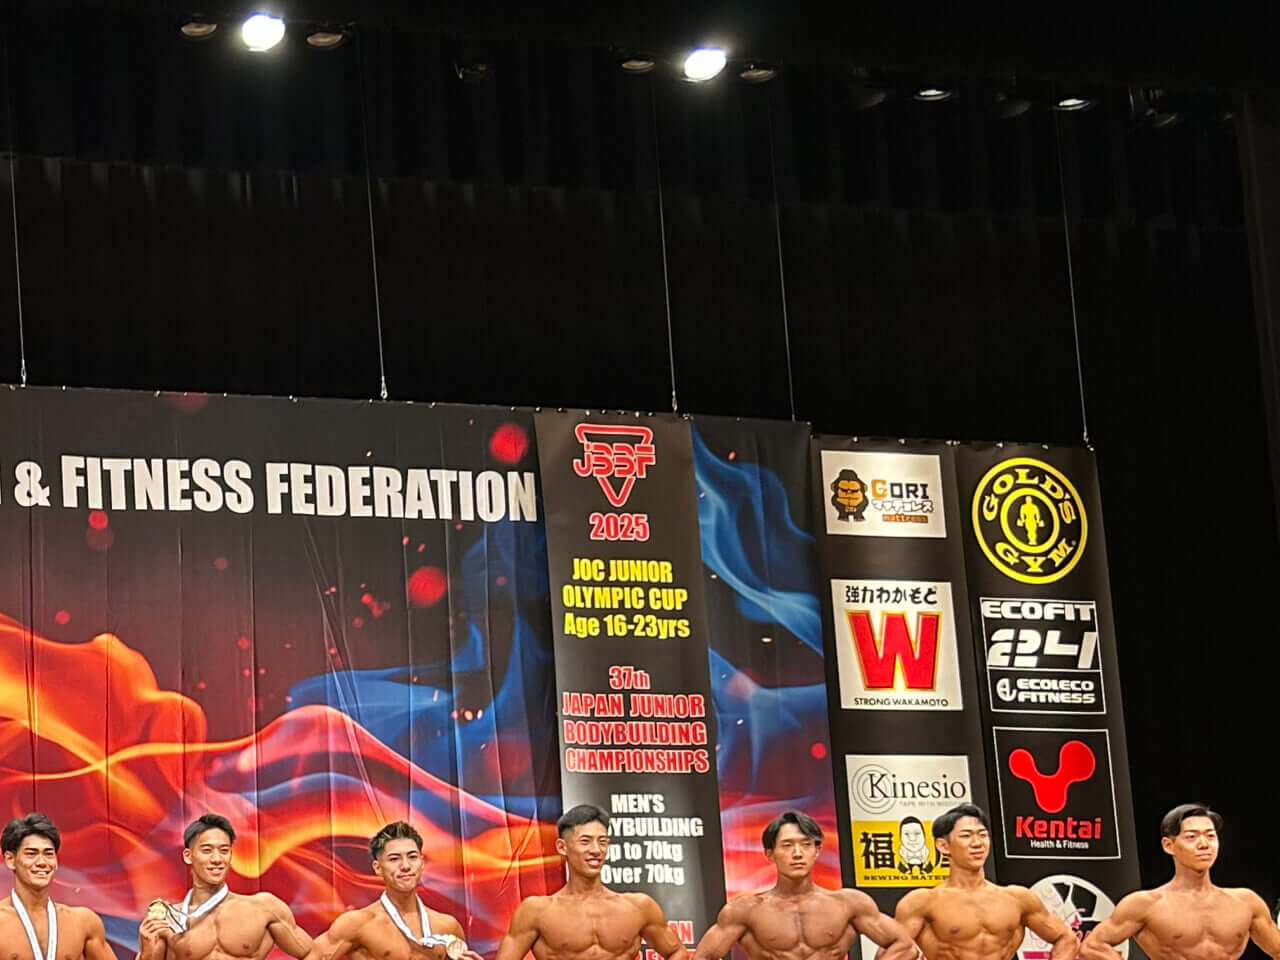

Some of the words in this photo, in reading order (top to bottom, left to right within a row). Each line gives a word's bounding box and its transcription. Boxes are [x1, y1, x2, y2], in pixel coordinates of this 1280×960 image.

[14, 461, 51, 507] &
[60, 455, 255, 514] FITNESS
[265, 462, 538, 523] FEDERATION
[871, 479, 929, 500] GORI
[983, 468, 1077, 525] GOLD'S
[589, 512, 650, 541] 2025
[995, 538, 1072, 573] GYM
[572, 558, 606, 582] JOC
[608, 559, 673, 583] JUNIOR
[562, 584, 645, 609] OLYMPIC
[648, 587, 688, 610] CUP
[845, 585, 938, 605] 強力わかもと
[982, 601, 1096, 621] ECOFIT
[563, 612, 600, 638] Age
[603, 613, 690, 640] 16-23yrs
[844, 610, 943, 691] W
[609, 666, 651, 690] 37th
[1016, 678, 1094, 691] ECOLECO
[562, 692, 624, 717] JAPAN
[629, 694, 706, 718] JUNIOR
[854, 697, 891, 707] STRONG
[893, 698, 949, 707] WAKAMOTO
[1018, 691, 1096, 704] FITNESS
[564, 720, 708, 746] BODYBUILDING
[566, 749, 710, 774] CHAMPIONSHIPS
[868, 773, 966, 799] Kinesio
[610, 793, 665, 814] MEN'S
[608, 817, 704, 837] YBUILDING
[1015, 816, 1102, 840] Kentai
[623, 841, 643, 860] to
[644, 840, 683, 862] 70kg
[1030, 839, 1055, 849] Health
[1055, 840, 1062, 849] &
[1063, 840, 1089, 850] Fitness
[600, 865, 644, 885] Over
[647, 864, 685, 886] 70kg
